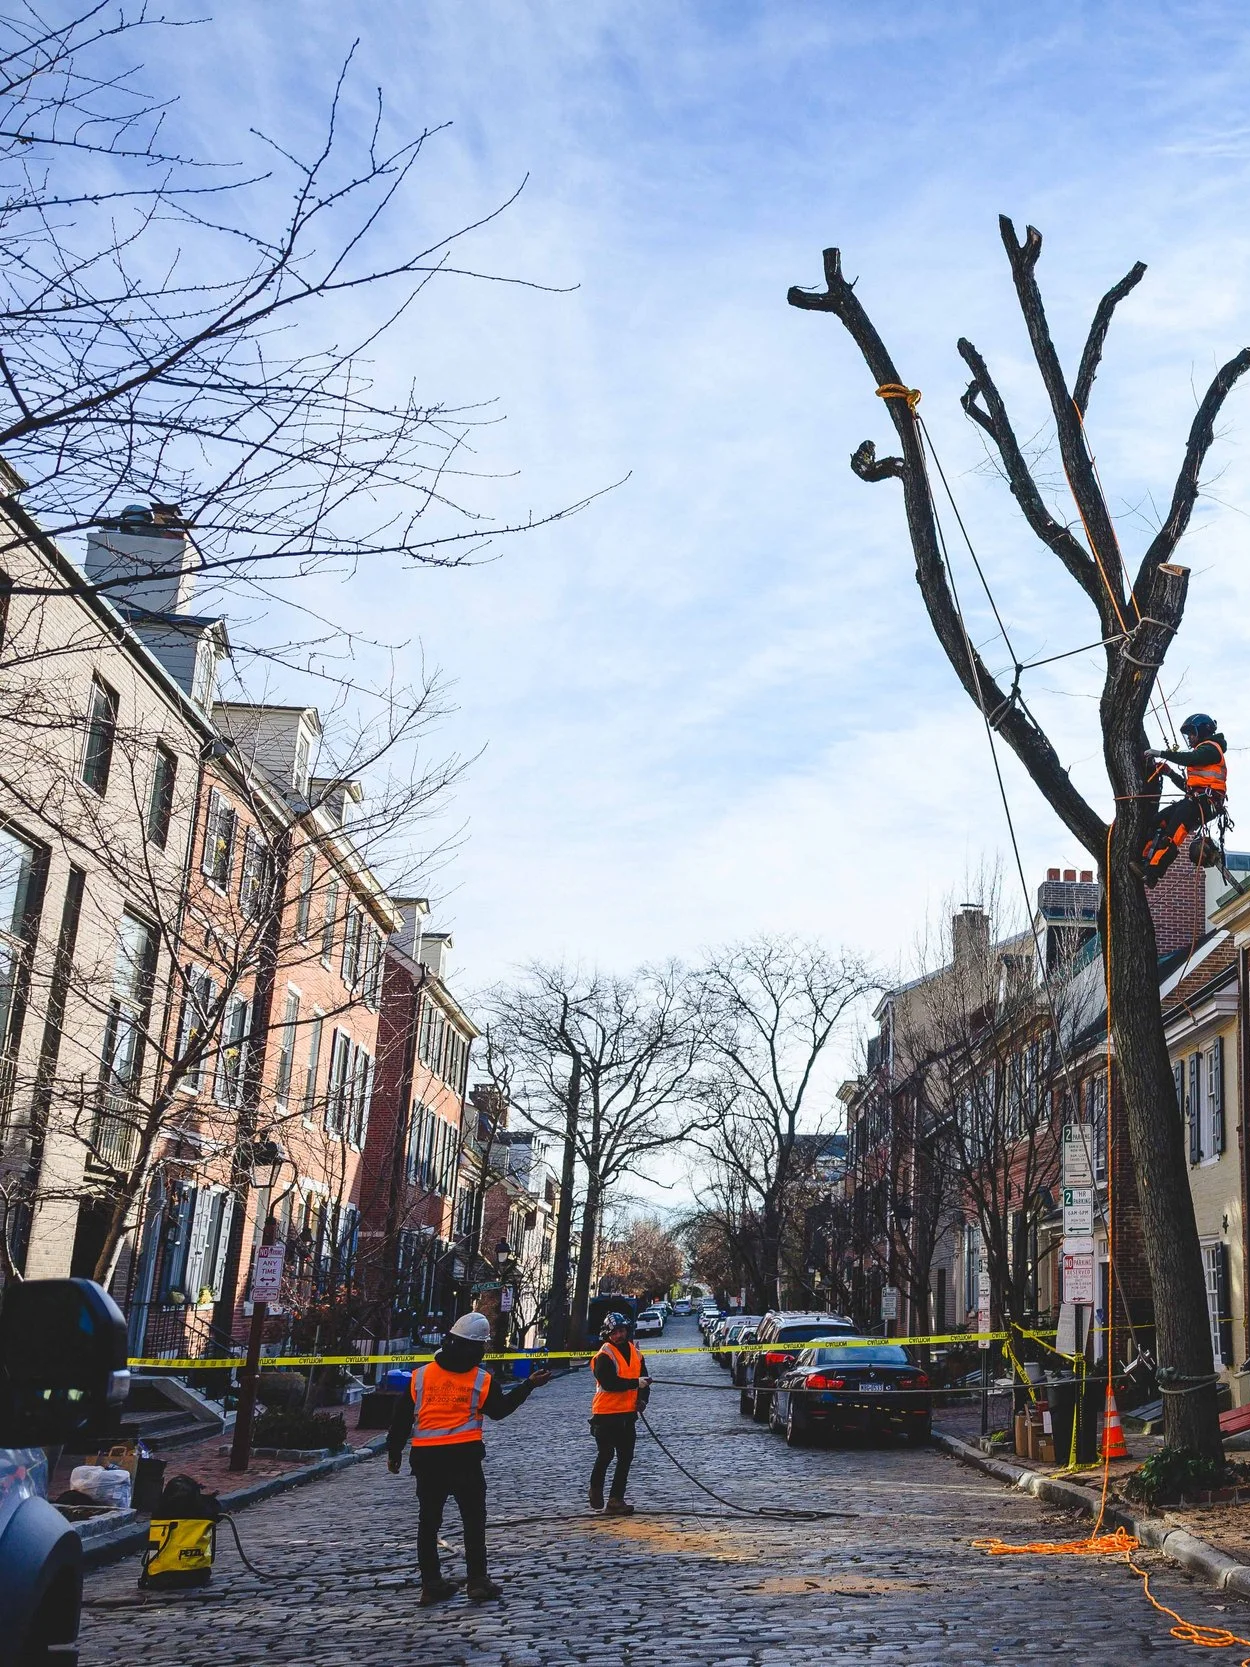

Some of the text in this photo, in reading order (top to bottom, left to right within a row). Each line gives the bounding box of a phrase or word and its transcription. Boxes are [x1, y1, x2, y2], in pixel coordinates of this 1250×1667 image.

[1065, 1129, 1071, 1140] 2
[1065, 1192, 1071, 1204] 2
[260, 1247, 268, 1257] NO
[1065, 1258, 1072, 1268] NO
